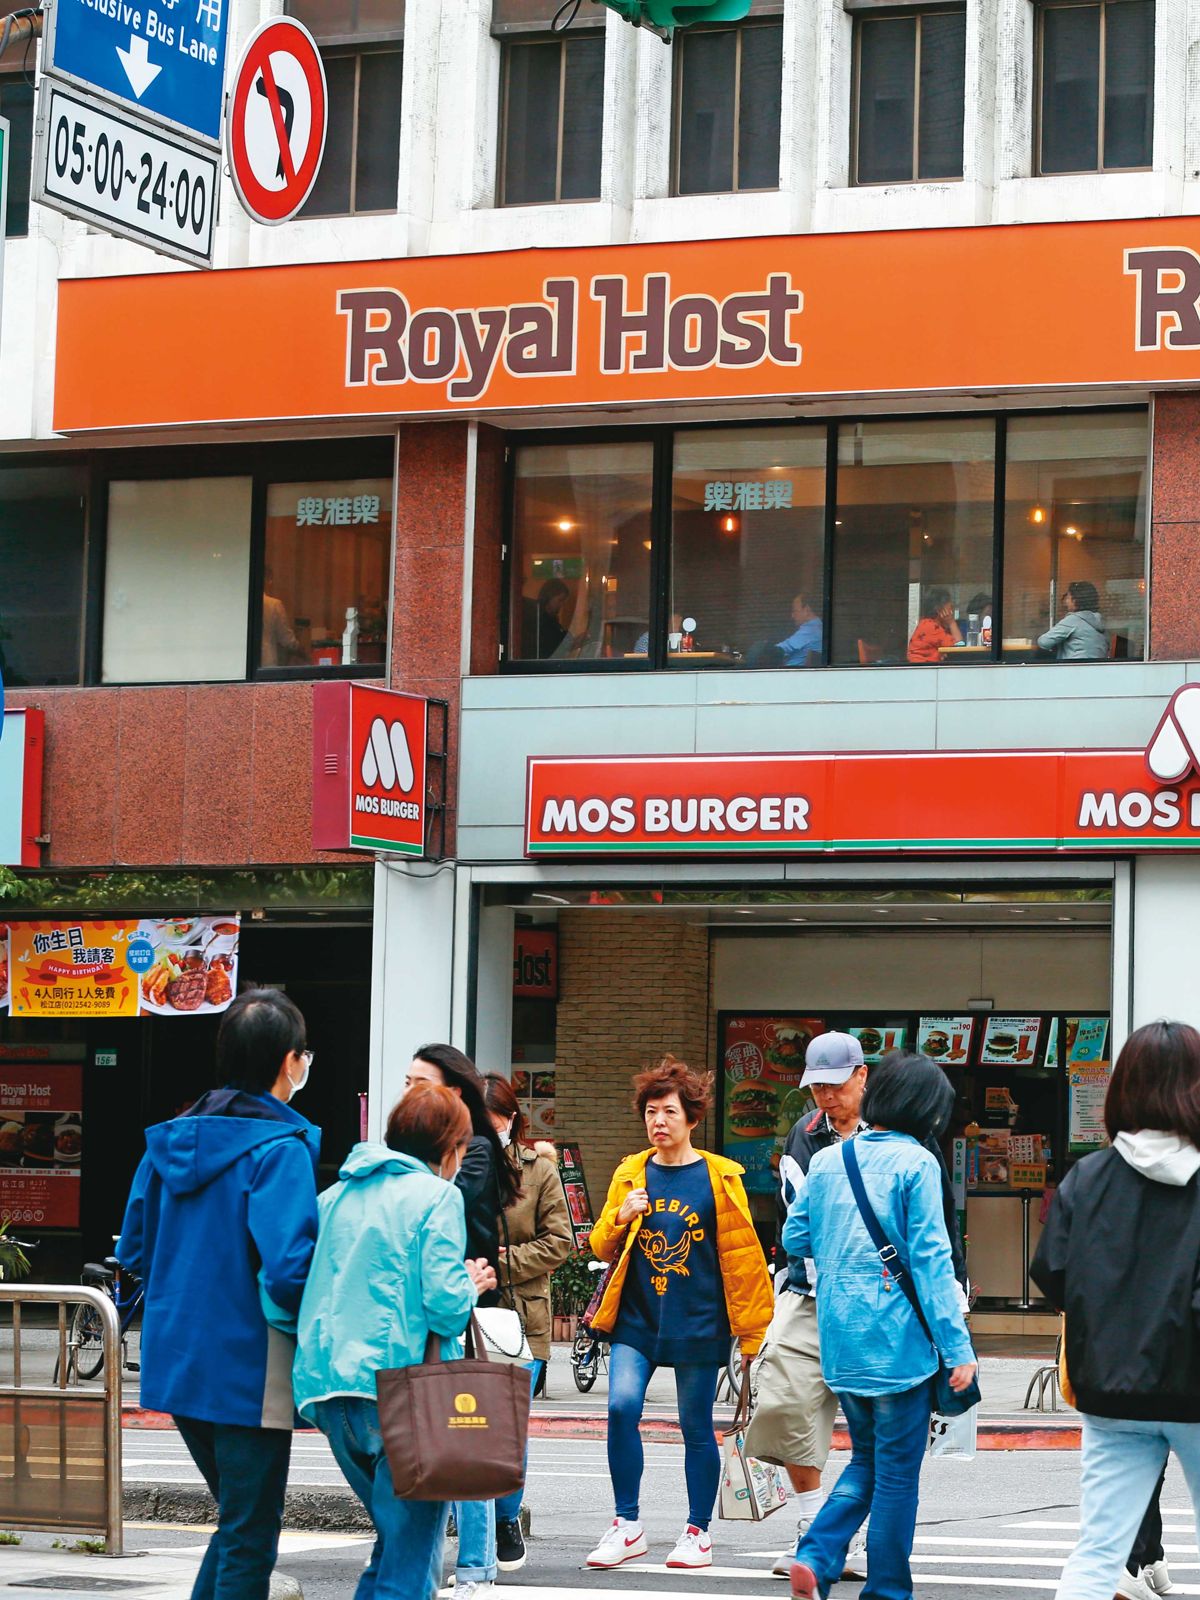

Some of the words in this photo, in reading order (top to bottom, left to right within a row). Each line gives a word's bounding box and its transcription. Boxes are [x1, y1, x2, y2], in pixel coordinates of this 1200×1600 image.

[146, 9, 175, 46] Bus
[179, 26, 218, 66] Lane
[54, 115, 206, 235] 05:00~24:00
[338, 276, 578, 402] Royal
[591, 272, 803, 374] Host
[296, 495, 379, 526] 樂雅樂
[704, 480, 793, 511] 樂雅樂
[355, 794, 379, 814] MOS
[380, 799, 420, 820] BURGER
[541, 797, 636, 834] MOS
[645, 796, 809, 833] BURGER
[1078, 791, 1181, 828] MOS
[33, 927, 84, 954] 你生日
[72, 947, 115, 964] 我請客
[48, 965, 70, 975] HAPPY
[72, 964, 104, 975] BIRTHDAY
[34, 987, 74, 999] 4人同行
[77, 986, 115, 999] 1人免費
